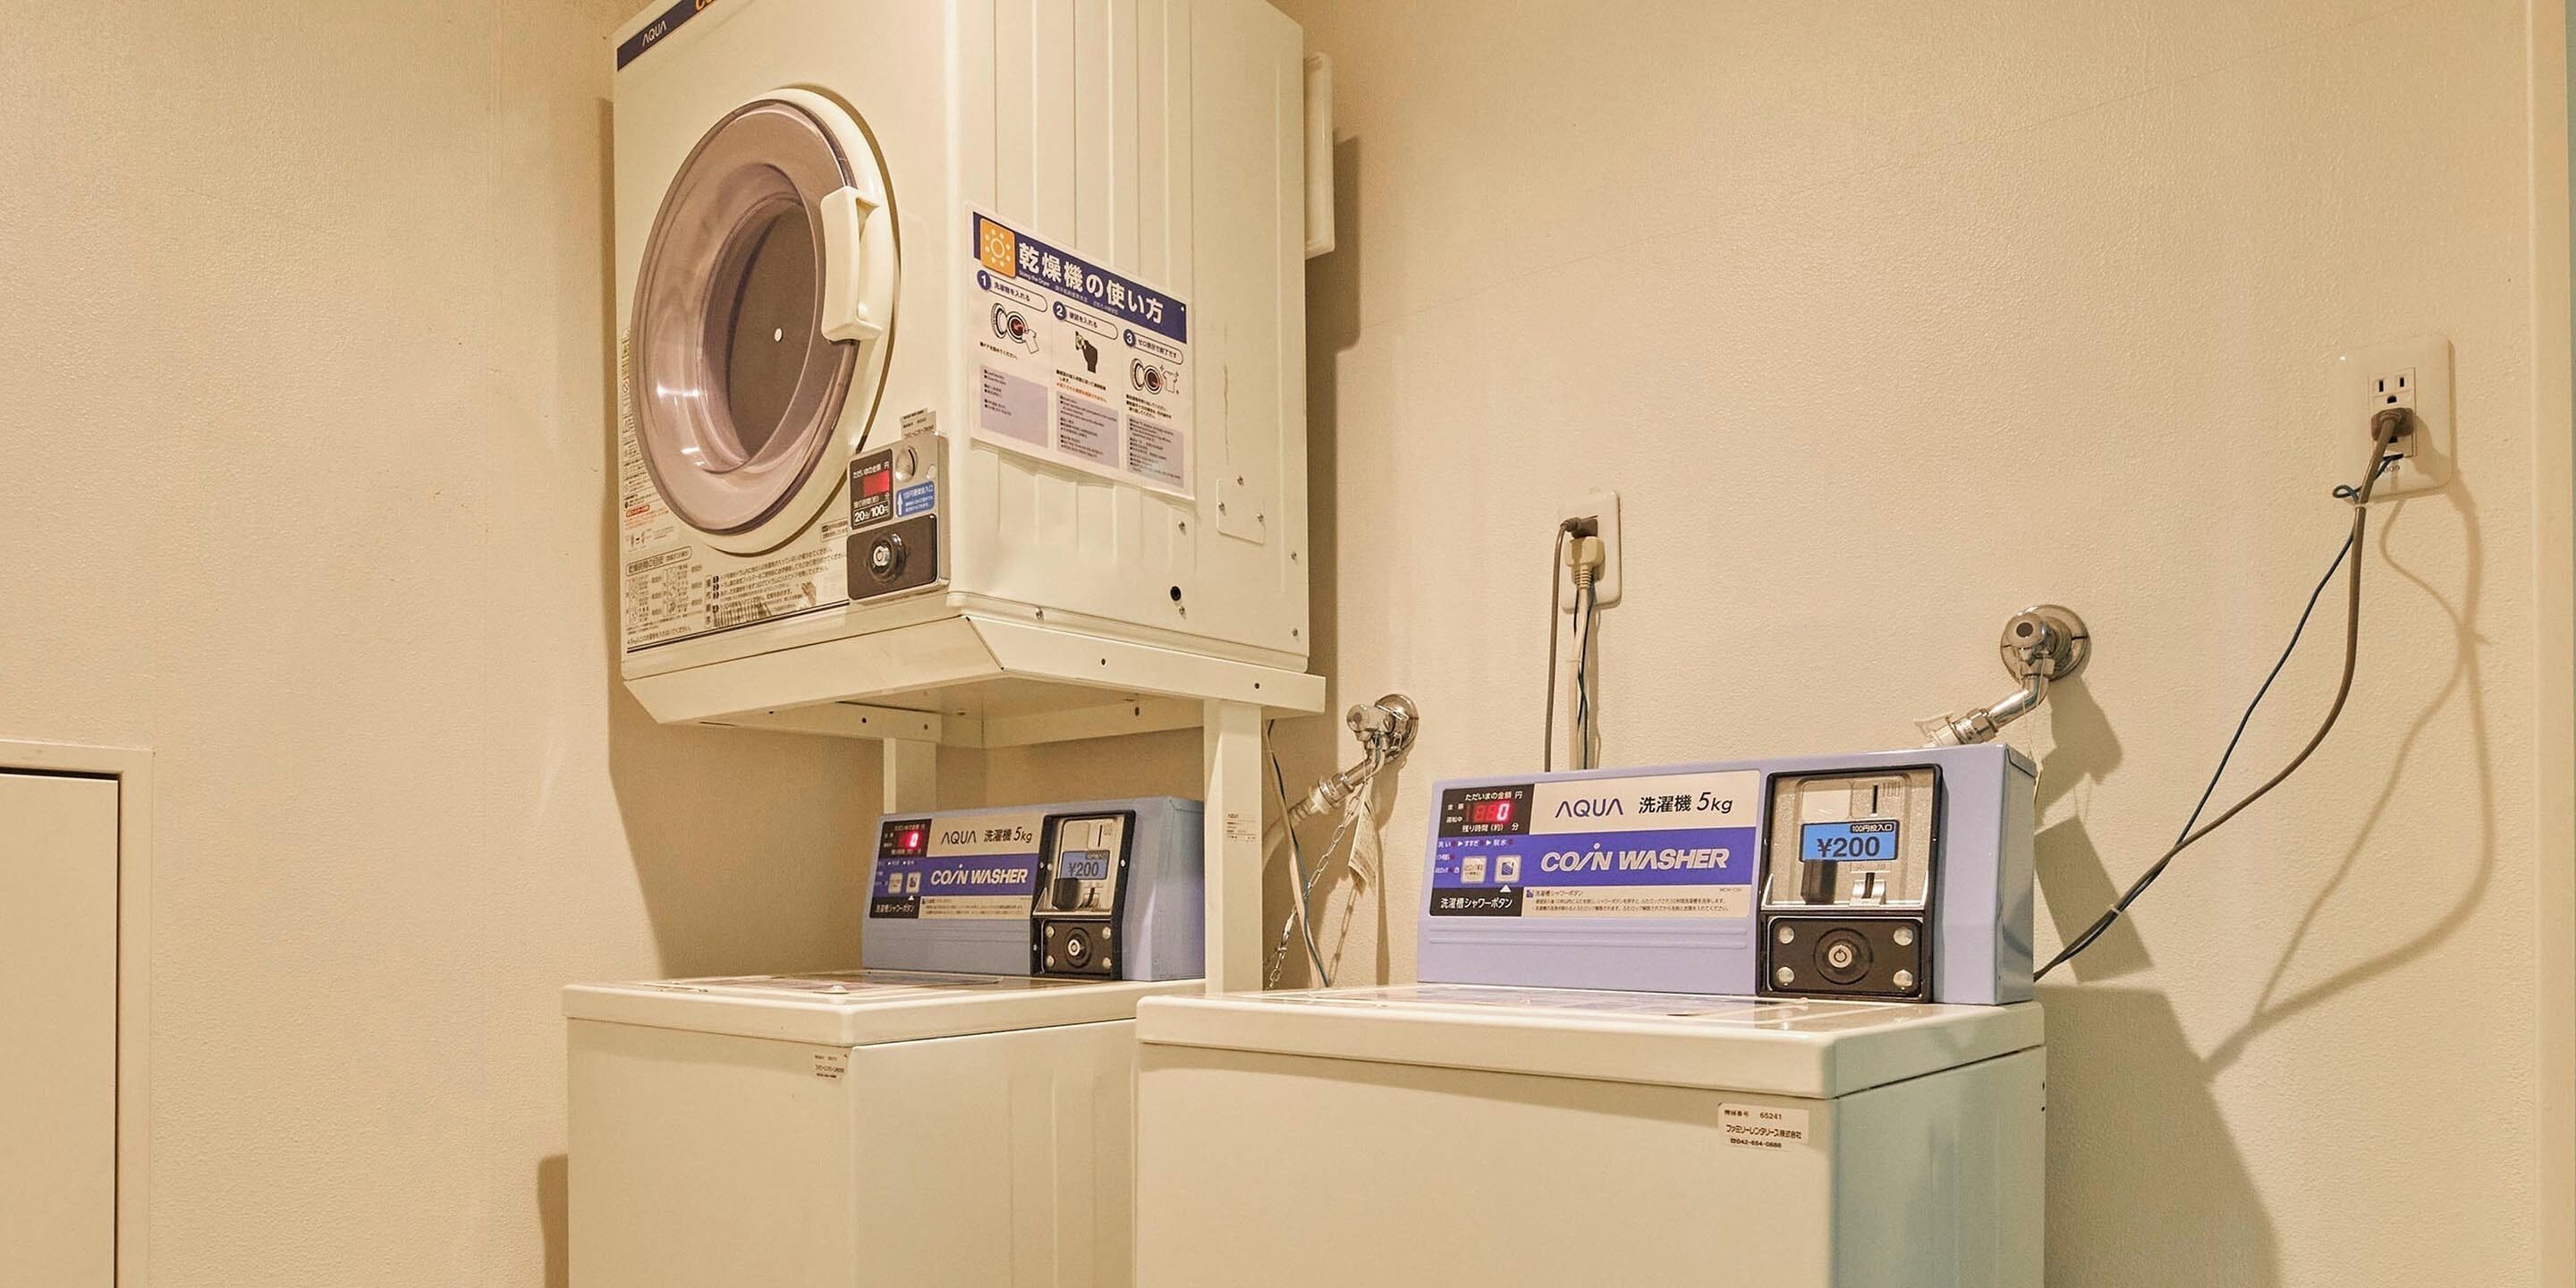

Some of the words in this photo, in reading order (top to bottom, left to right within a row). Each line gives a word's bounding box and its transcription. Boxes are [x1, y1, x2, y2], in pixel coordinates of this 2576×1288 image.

[642, 21, 667, 47] AQUA
[980, 275, 987, 286] 1
[1019, 242, 1164, 325] 乾燥機の使い方
[1056, 305, 1063, 317] 2
[1126, 333, 1132, 344] 3
[1514, 791, 1523, 800] 円
[1555, 799, 1624, 818] AQUA
[1638, 794, 1692, 814] 洗濯機
[1696, 792, 1733, 814] 5kg
[1496, 802, 1511, 821] 0
[941, 830, 978, 846] AQUA
[1013, 826, 1033, 843] 5kg
[1511, 823, 1520, 831] 分
[1817, 835, 1880, 858] ¥200
[1540, 843, 1614, 872] COIN
[1619, 848, 1731, 871] WASHER
[931, 864, 970, 886] COIN
[970, 869, 1029, 886] WASHER
[1068, 861, 1100, 877] ¥200
